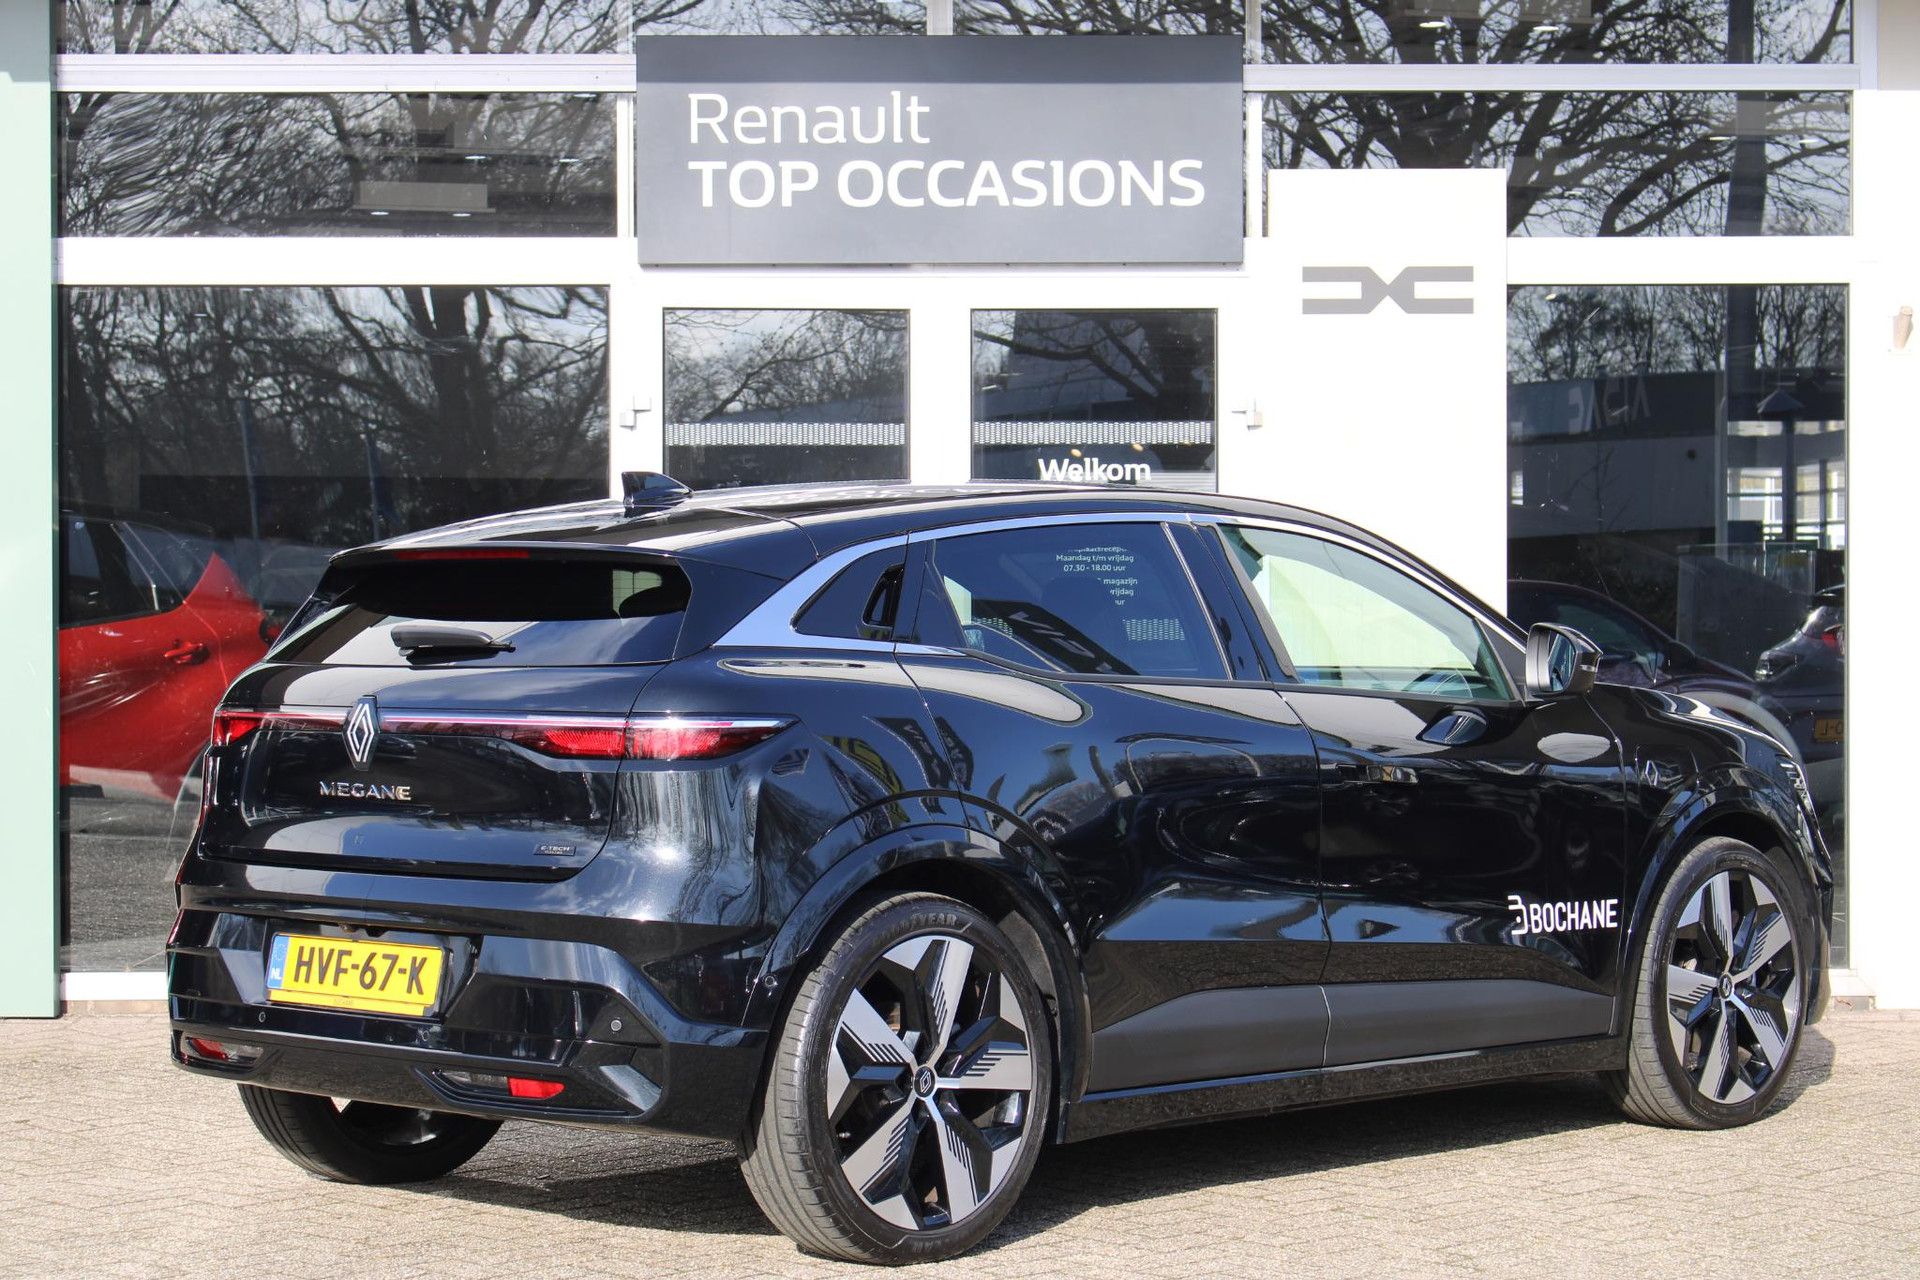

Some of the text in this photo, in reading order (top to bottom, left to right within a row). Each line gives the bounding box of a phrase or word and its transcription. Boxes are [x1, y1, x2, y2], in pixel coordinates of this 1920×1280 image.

[688, 90, 930, 144] Renault
[688, 159, 1205, 208] TOP OCCASIONS
[1038, 457, 1152, 481] Welkom
[1056, 554, 1134, 563] Maandag t/m vrijdag
[1063, 564, 1086, 572] 07.30
[1103, 577, 1138, 586] magazijn
[319, 780, 412, 801] MEGANE
[1529, 898, 1619, 934] BOCHANE
[270, 967, 282, 980] NL
[293, 945, 429, 996] HVF-67-K
